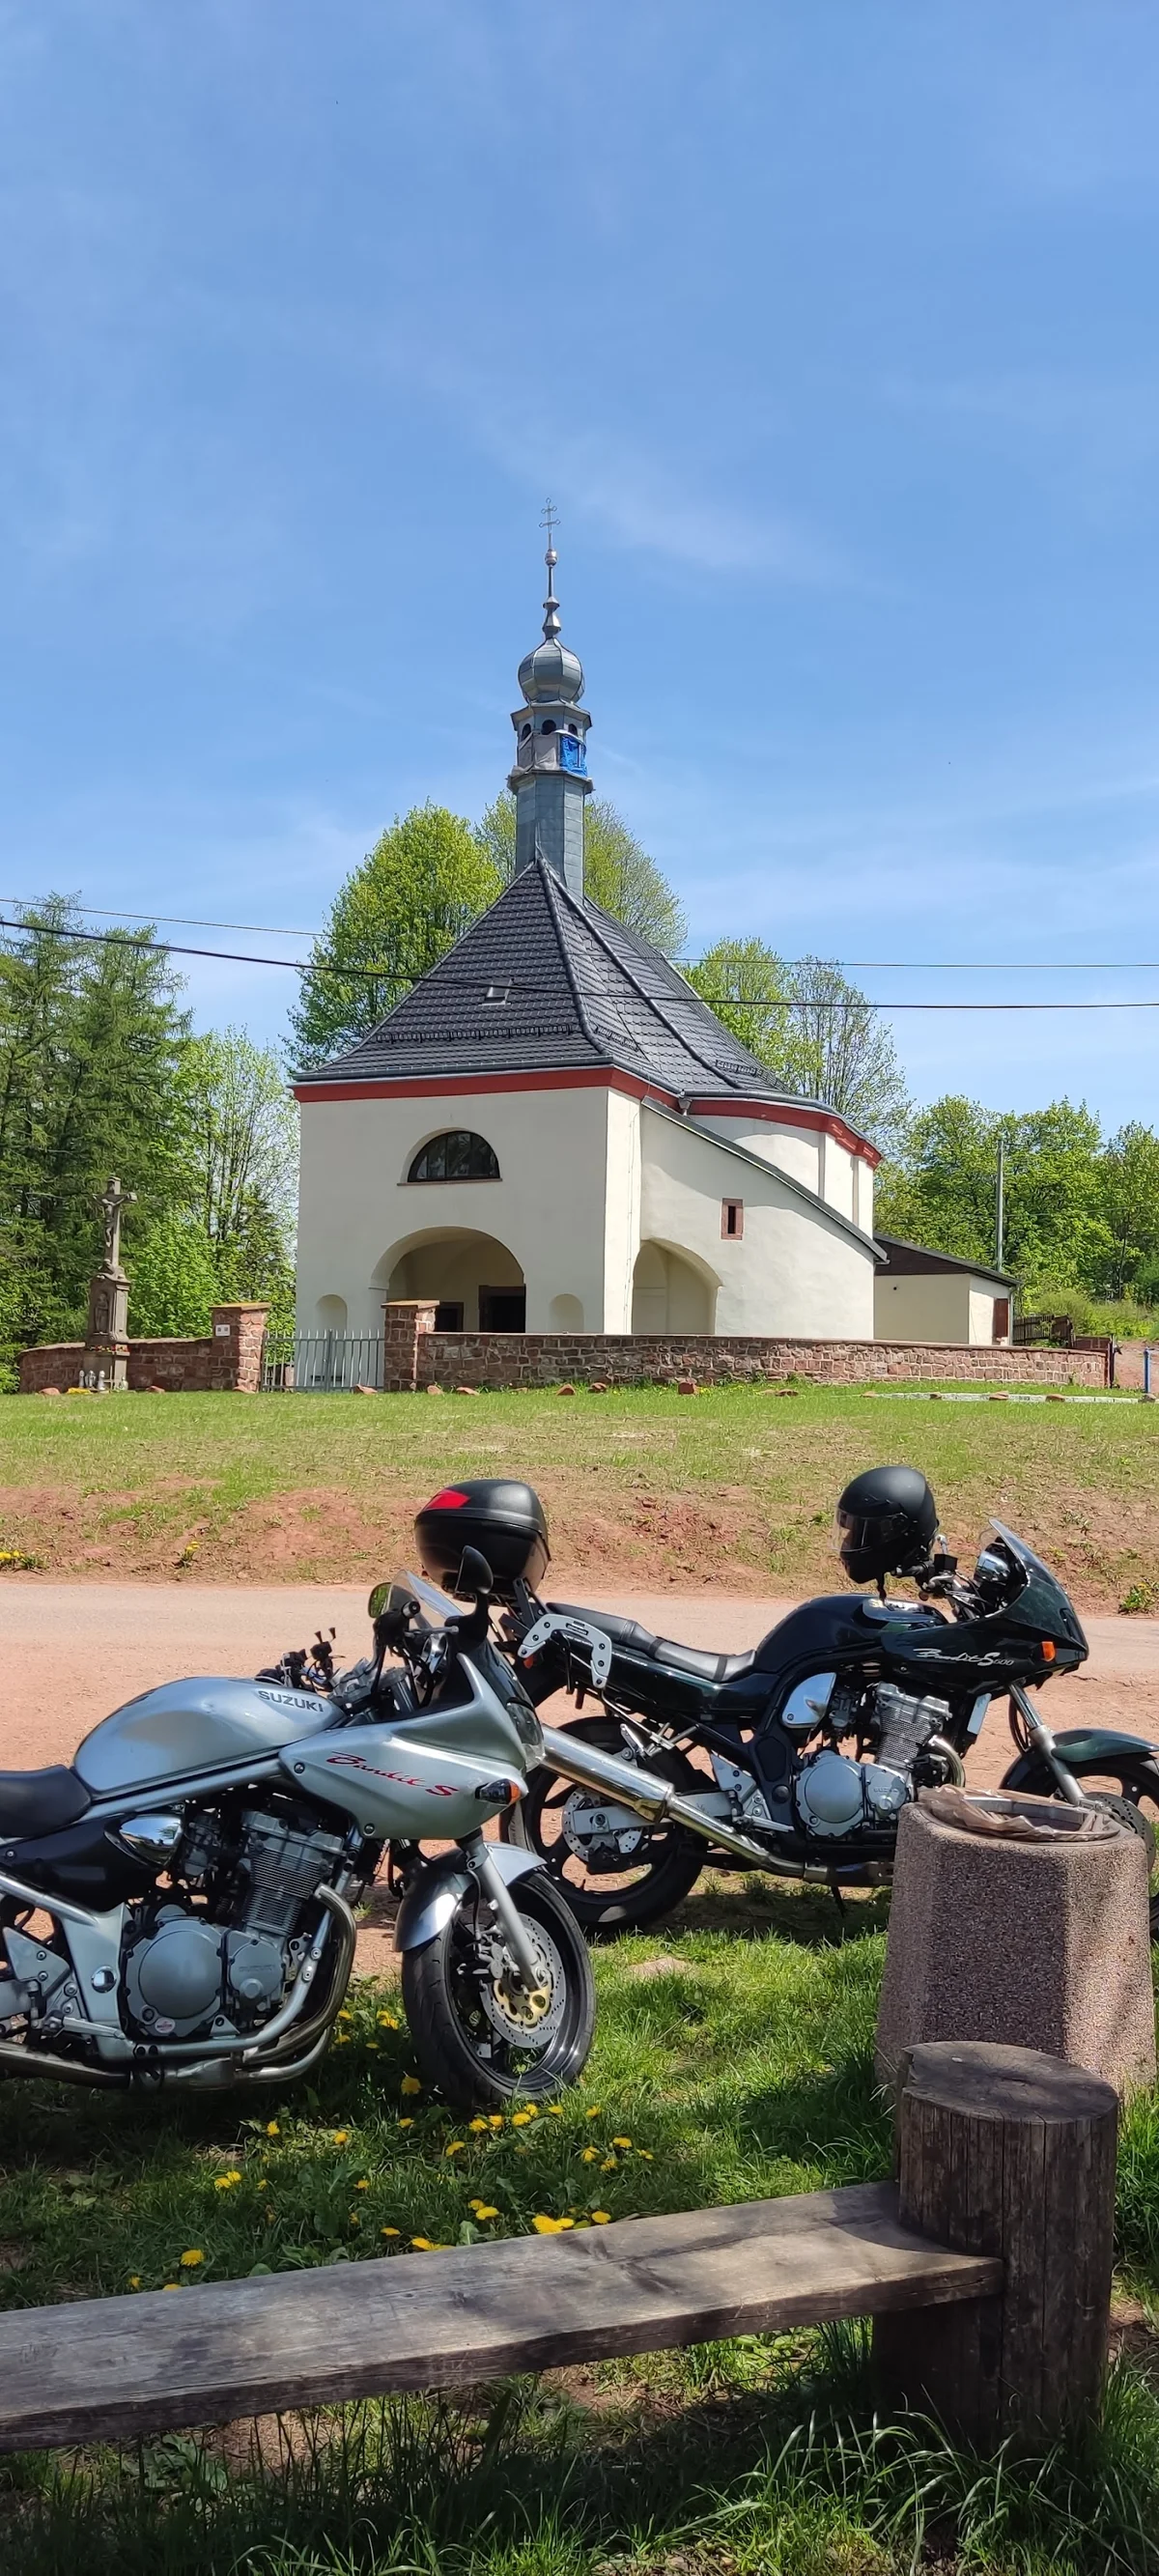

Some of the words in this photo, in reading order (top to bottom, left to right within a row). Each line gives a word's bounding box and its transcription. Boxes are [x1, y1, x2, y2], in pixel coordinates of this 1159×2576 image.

[258, 1690, 325, 1713] SUZUKI
[325, 1750, 427, 1787] Bandit
[425, 1785, 459, 1797] S
